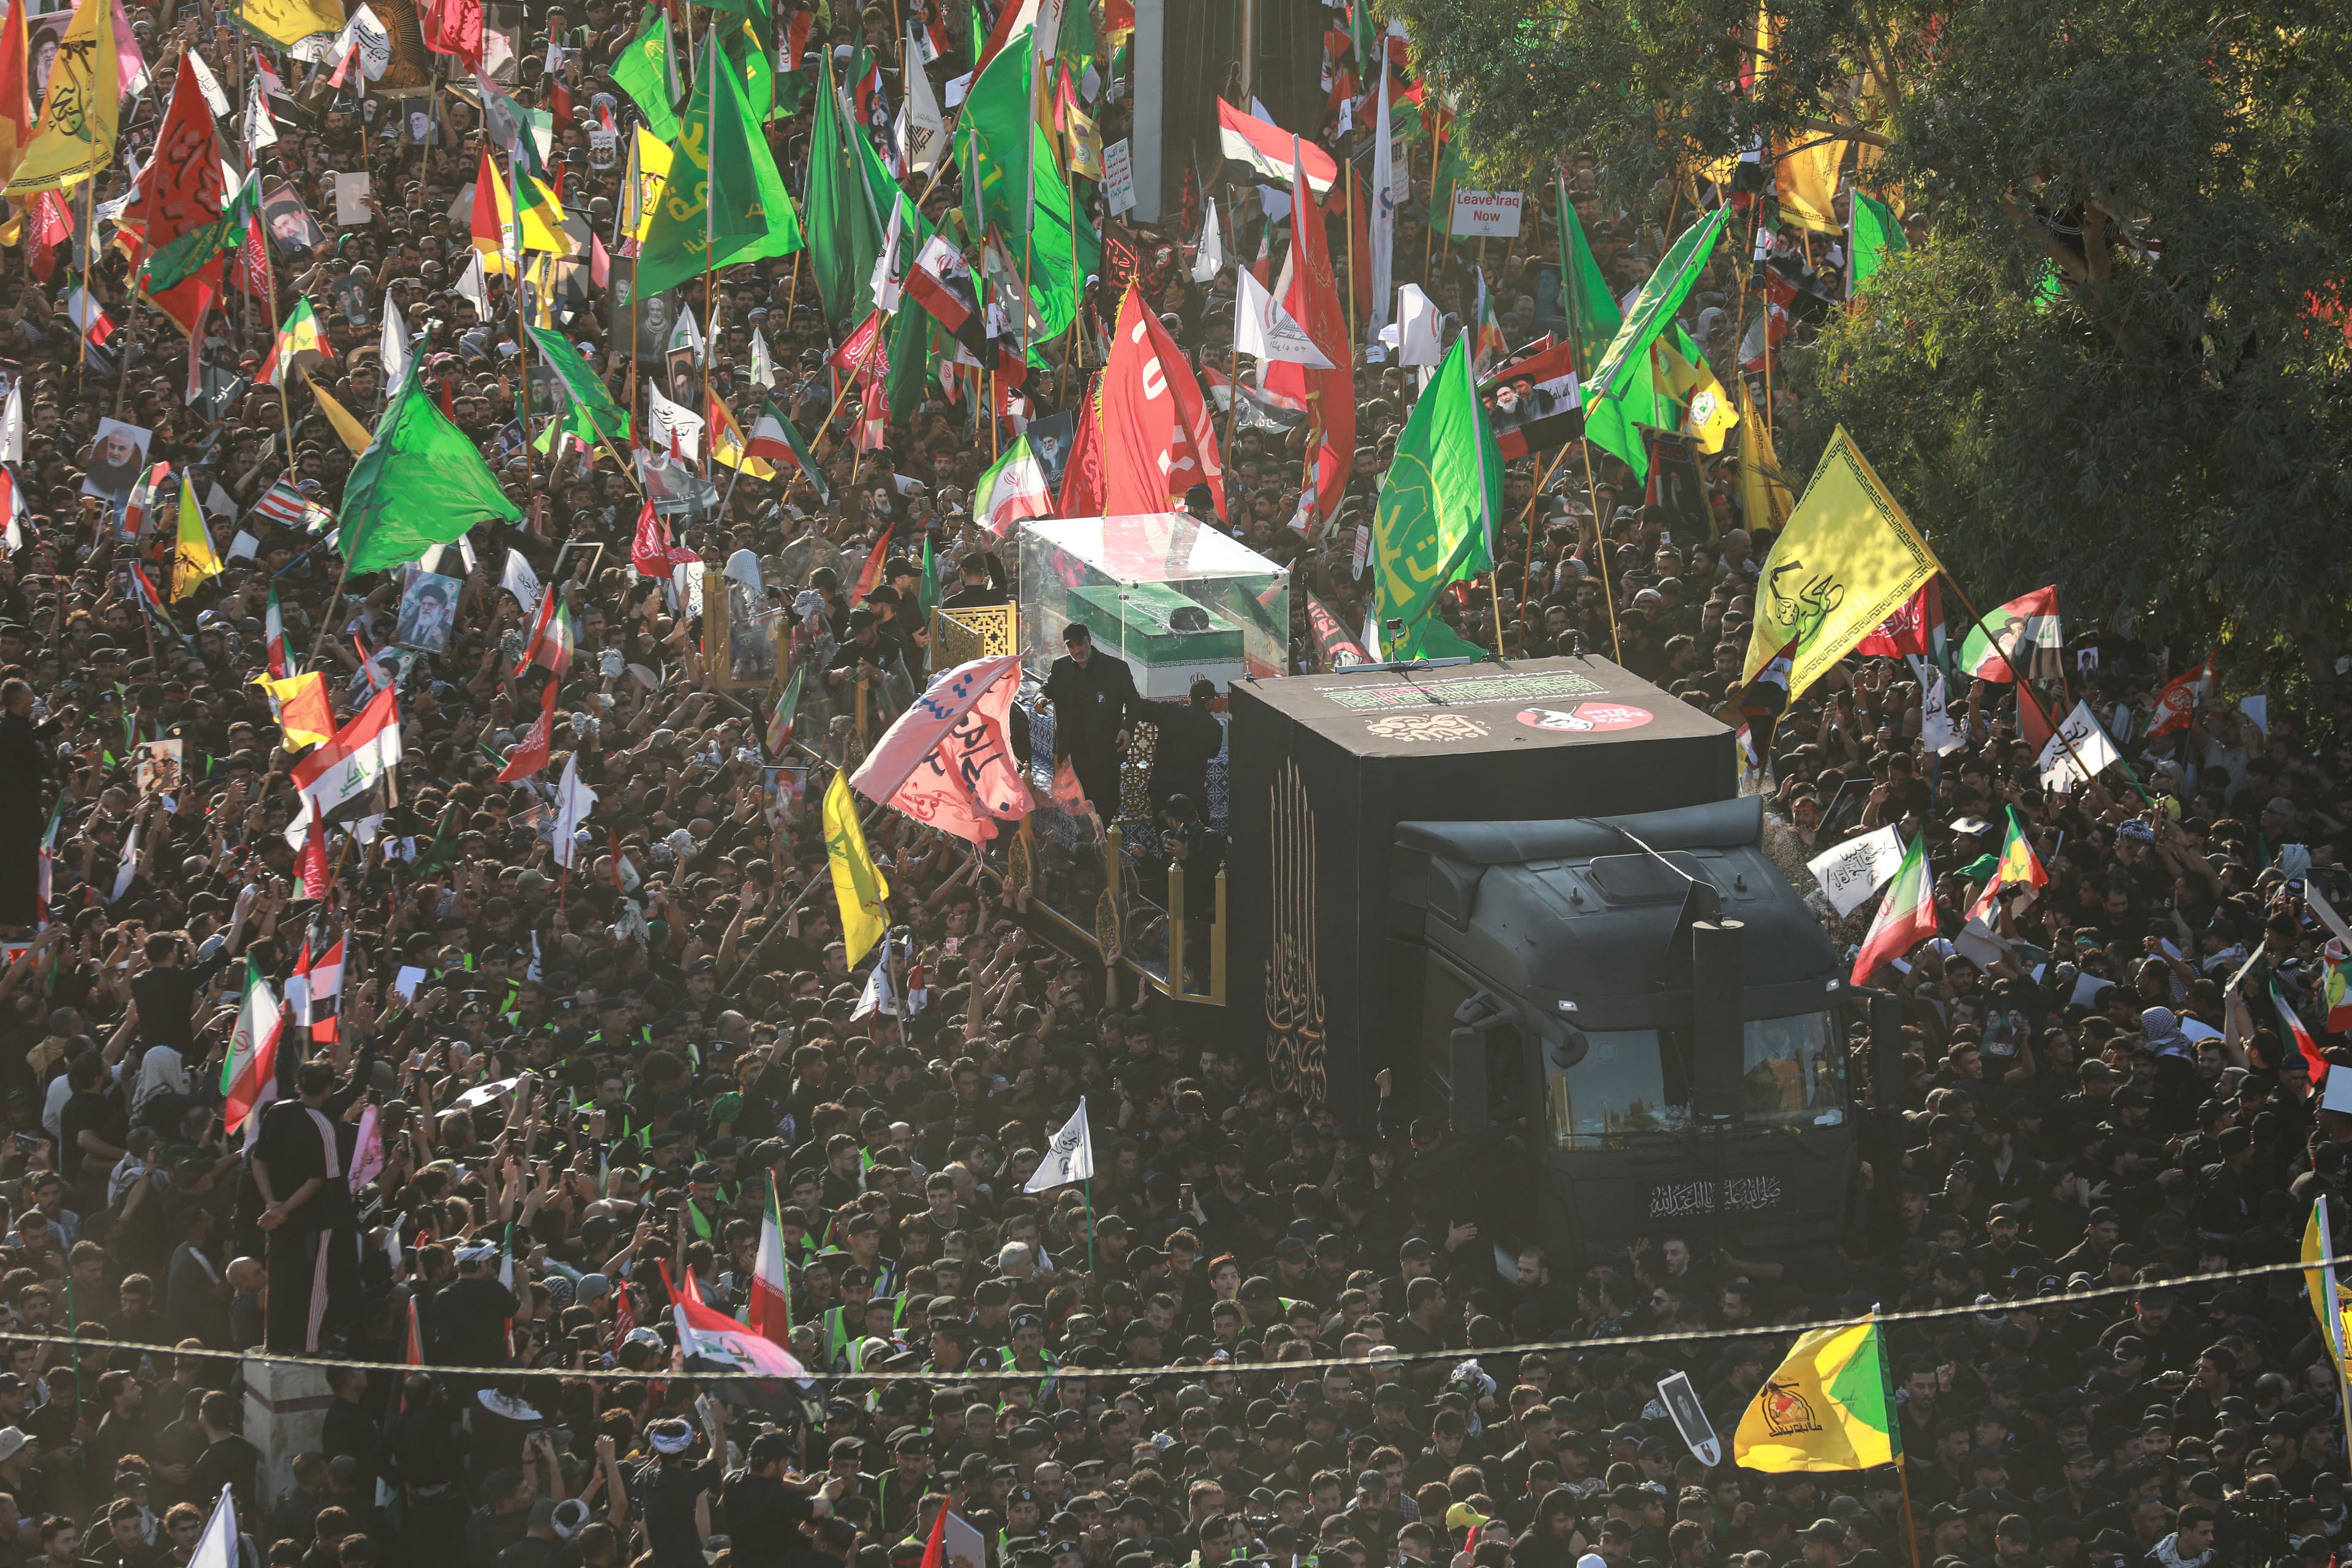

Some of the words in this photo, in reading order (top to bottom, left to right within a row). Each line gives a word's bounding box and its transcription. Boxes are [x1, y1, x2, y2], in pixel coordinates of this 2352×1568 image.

[1457, 194, 1493, 205] Leave
[1496, 195, 1520, 208] Iraq
[1474, 210, 1501, 222] Now
